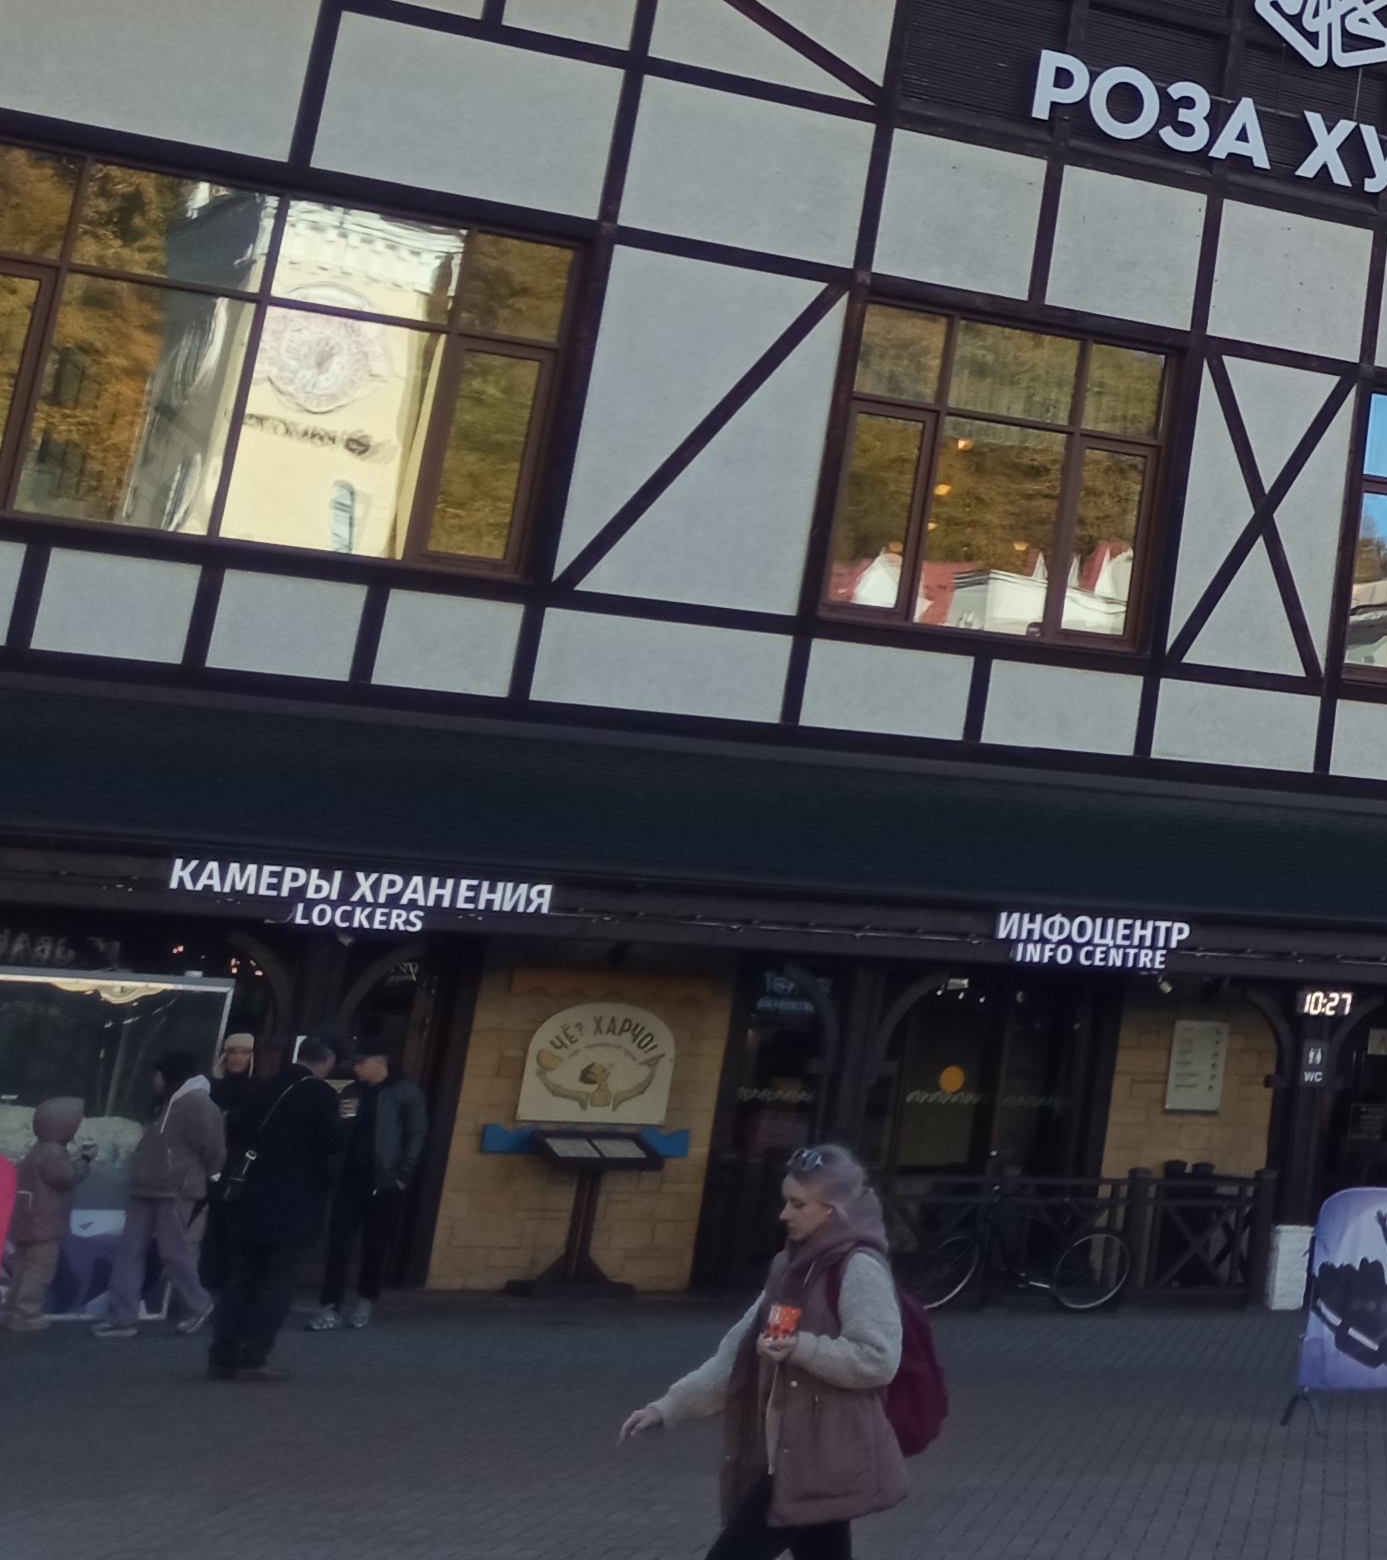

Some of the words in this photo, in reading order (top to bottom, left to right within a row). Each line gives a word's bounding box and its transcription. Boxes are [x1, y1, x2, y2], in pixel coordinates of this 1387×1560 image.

[1031, 48, 1271, 170] РОЗА
[169, 857, 343, 901] КАМЕРЫ
[350, 871, 553, 913] ХРАНЕНИЯ
[295, 903, 425, 932] LOCKERS
[996, 912, 1191, 949] ИНФОЦЕНТР
[1016, 943, 1073, 965] INFO
[1079, 945, 1167, 970] CENTRE
[1303, 991, 1353, 1017] 10:27
[550, 1021, 584, 1050] ЧЁ?
[593, 1015, 658, 1054] ХАРЧО!
[1303, 1071, 1323, 1083] WC
